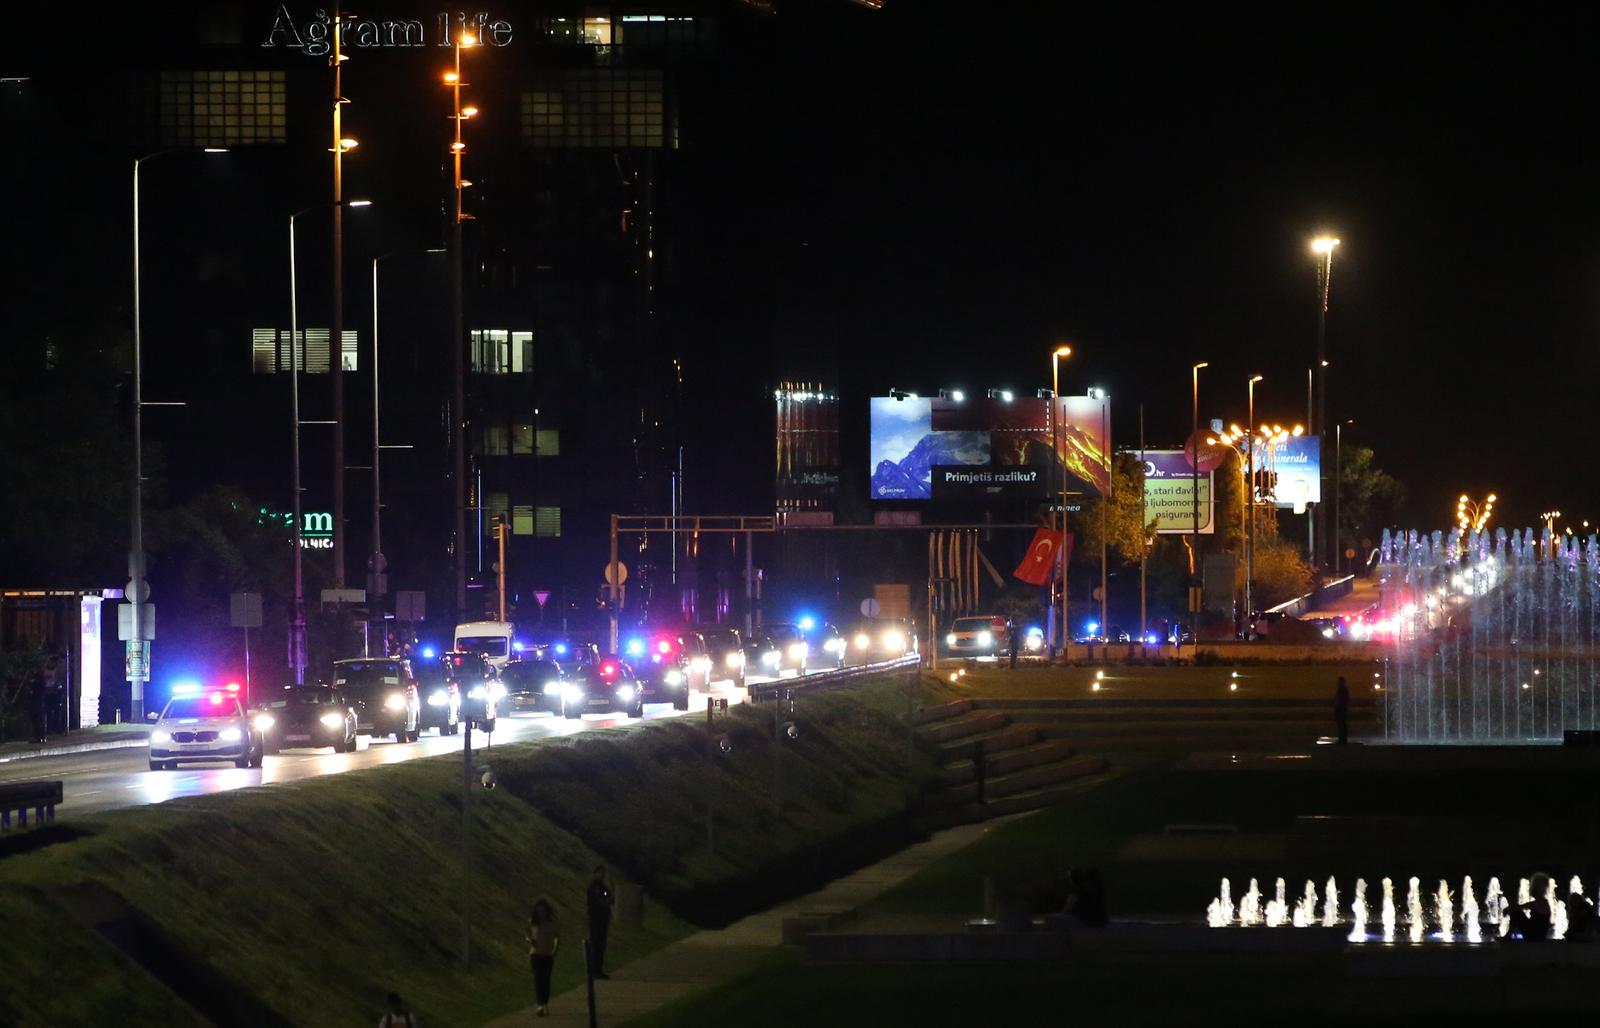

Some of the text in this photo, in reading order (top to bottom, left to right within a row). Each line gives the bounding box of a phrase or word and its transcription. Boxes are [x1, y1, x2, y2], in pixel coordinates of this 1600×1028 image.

[261, 4, 514, 56] Agram life
[945, 471, 1037, 485] Primjetiš razliku?
[1153, 486, 1174, 495] stari
